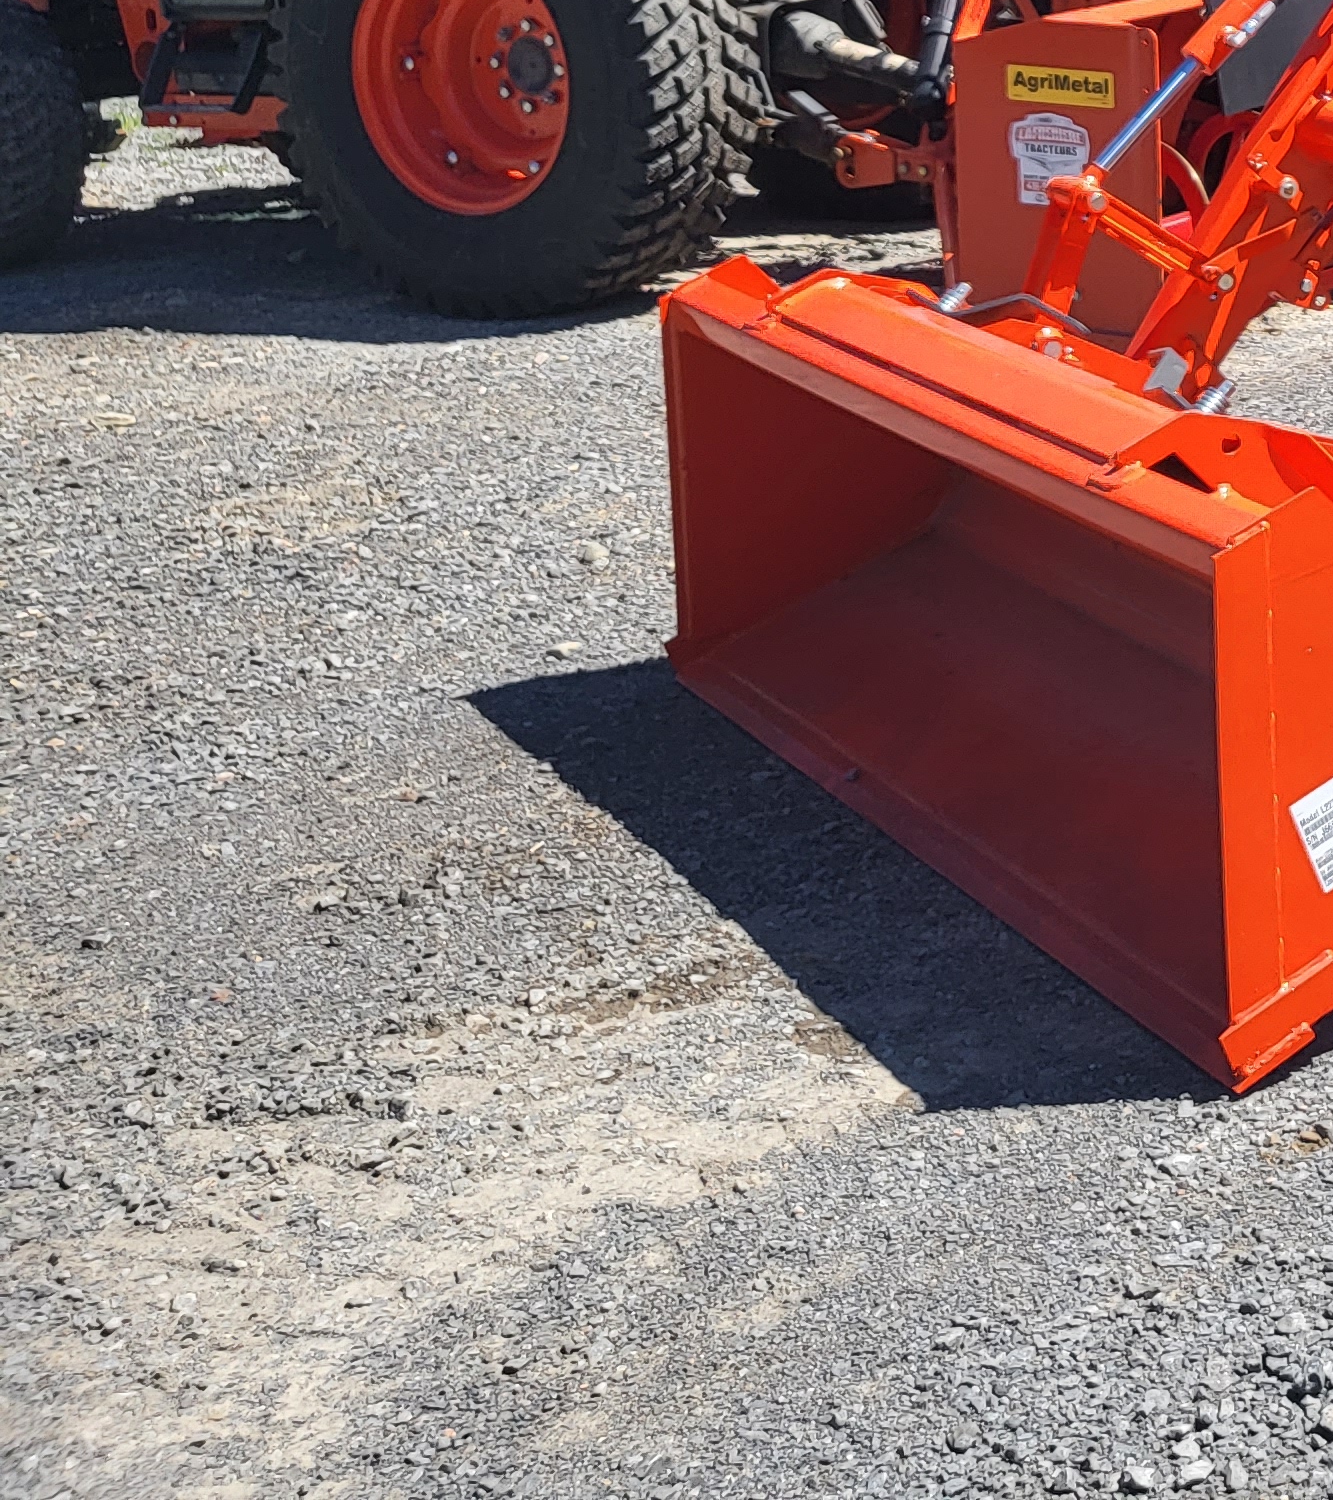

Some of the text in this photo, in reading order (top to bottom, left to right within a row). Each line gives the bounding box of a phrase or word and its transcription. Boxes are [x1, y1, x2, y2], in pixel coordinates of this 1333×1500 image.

[1013, 70, 1110, 95] AgriMetal
[1025, 143, 1078, 156] TRACTEURS
[1299, 808, 1320, 828] Model
